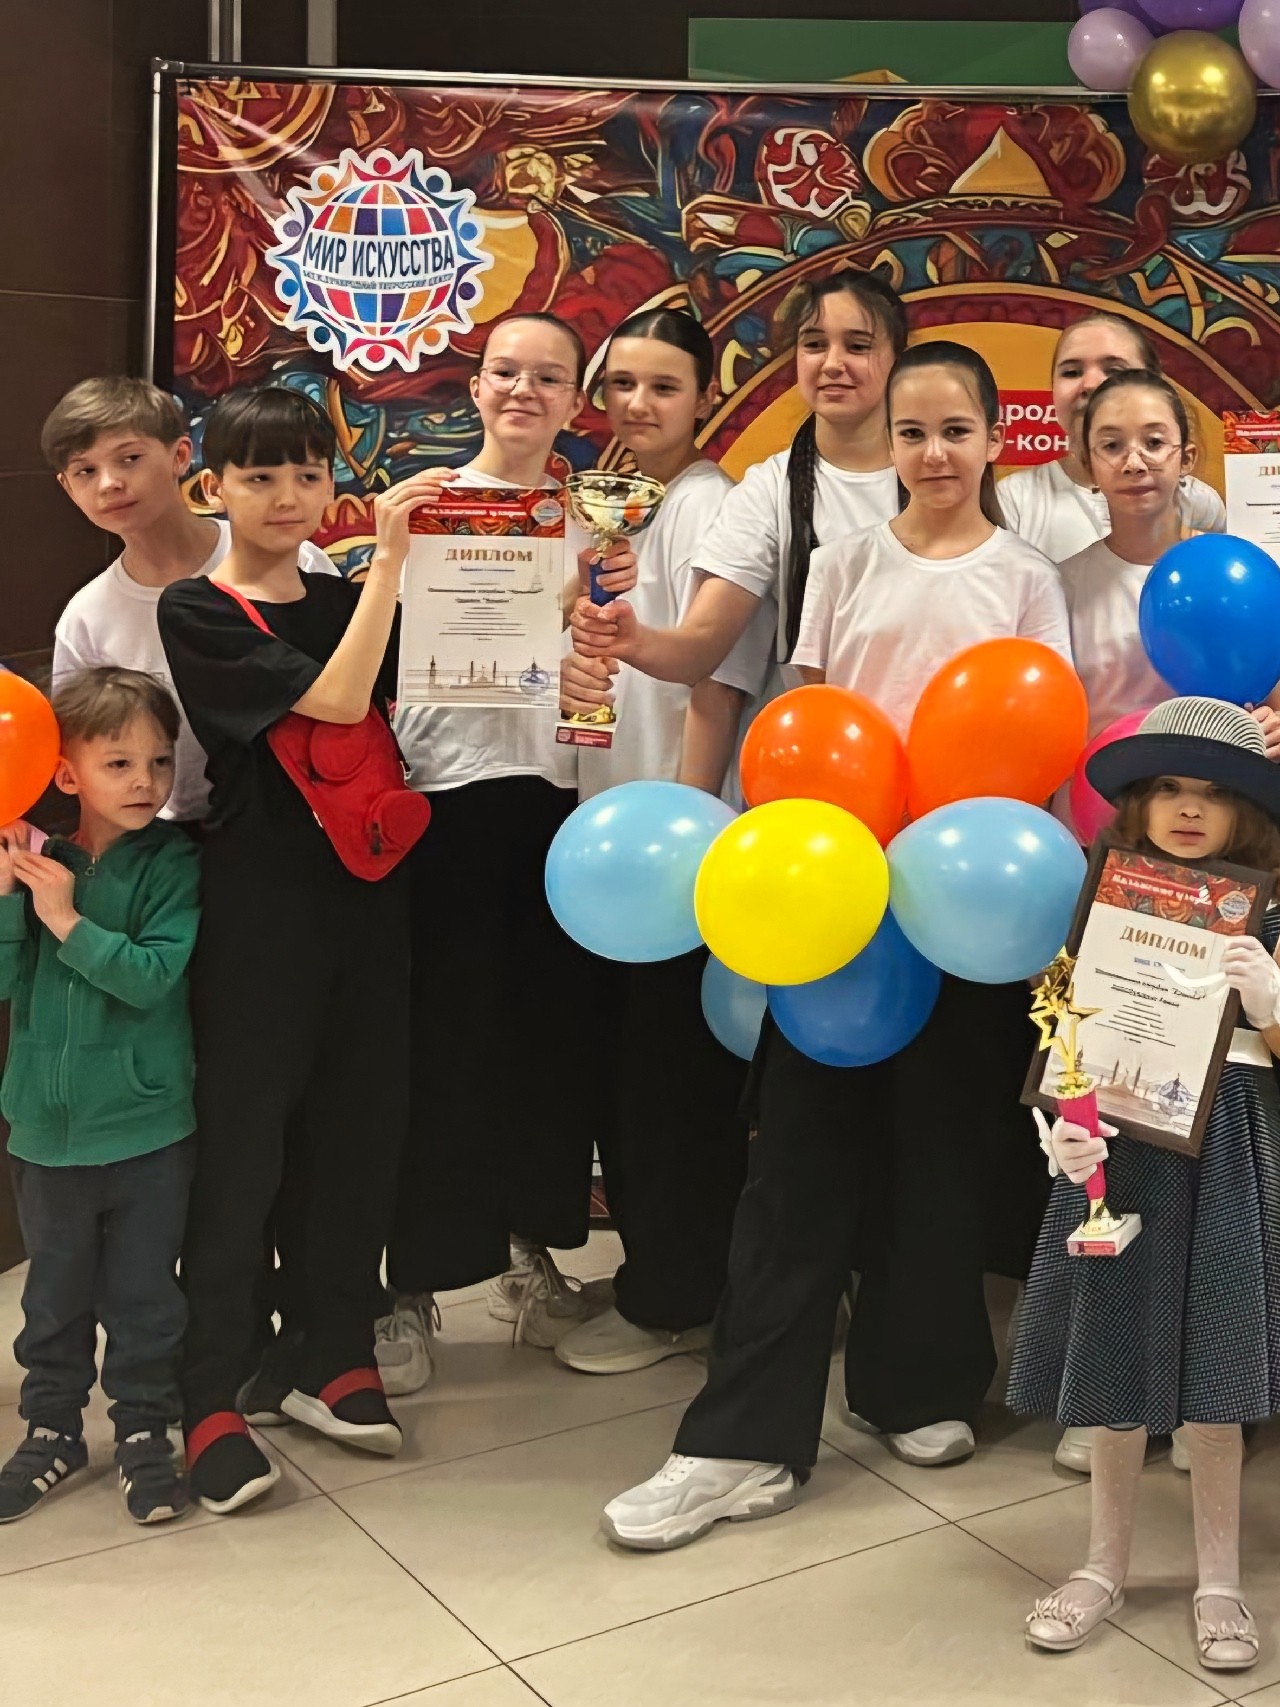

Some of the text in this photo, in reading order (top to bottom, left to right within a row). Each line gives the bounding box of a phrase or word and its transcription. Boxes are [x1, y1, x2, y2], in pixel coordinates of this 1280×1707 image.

[303, 232, 455, 278] МИР ИСКУССТВА
[445, 548, 533, 562] ДИПЛОМ
[1119, 925, 1207, 960] ДИПЛОМ
